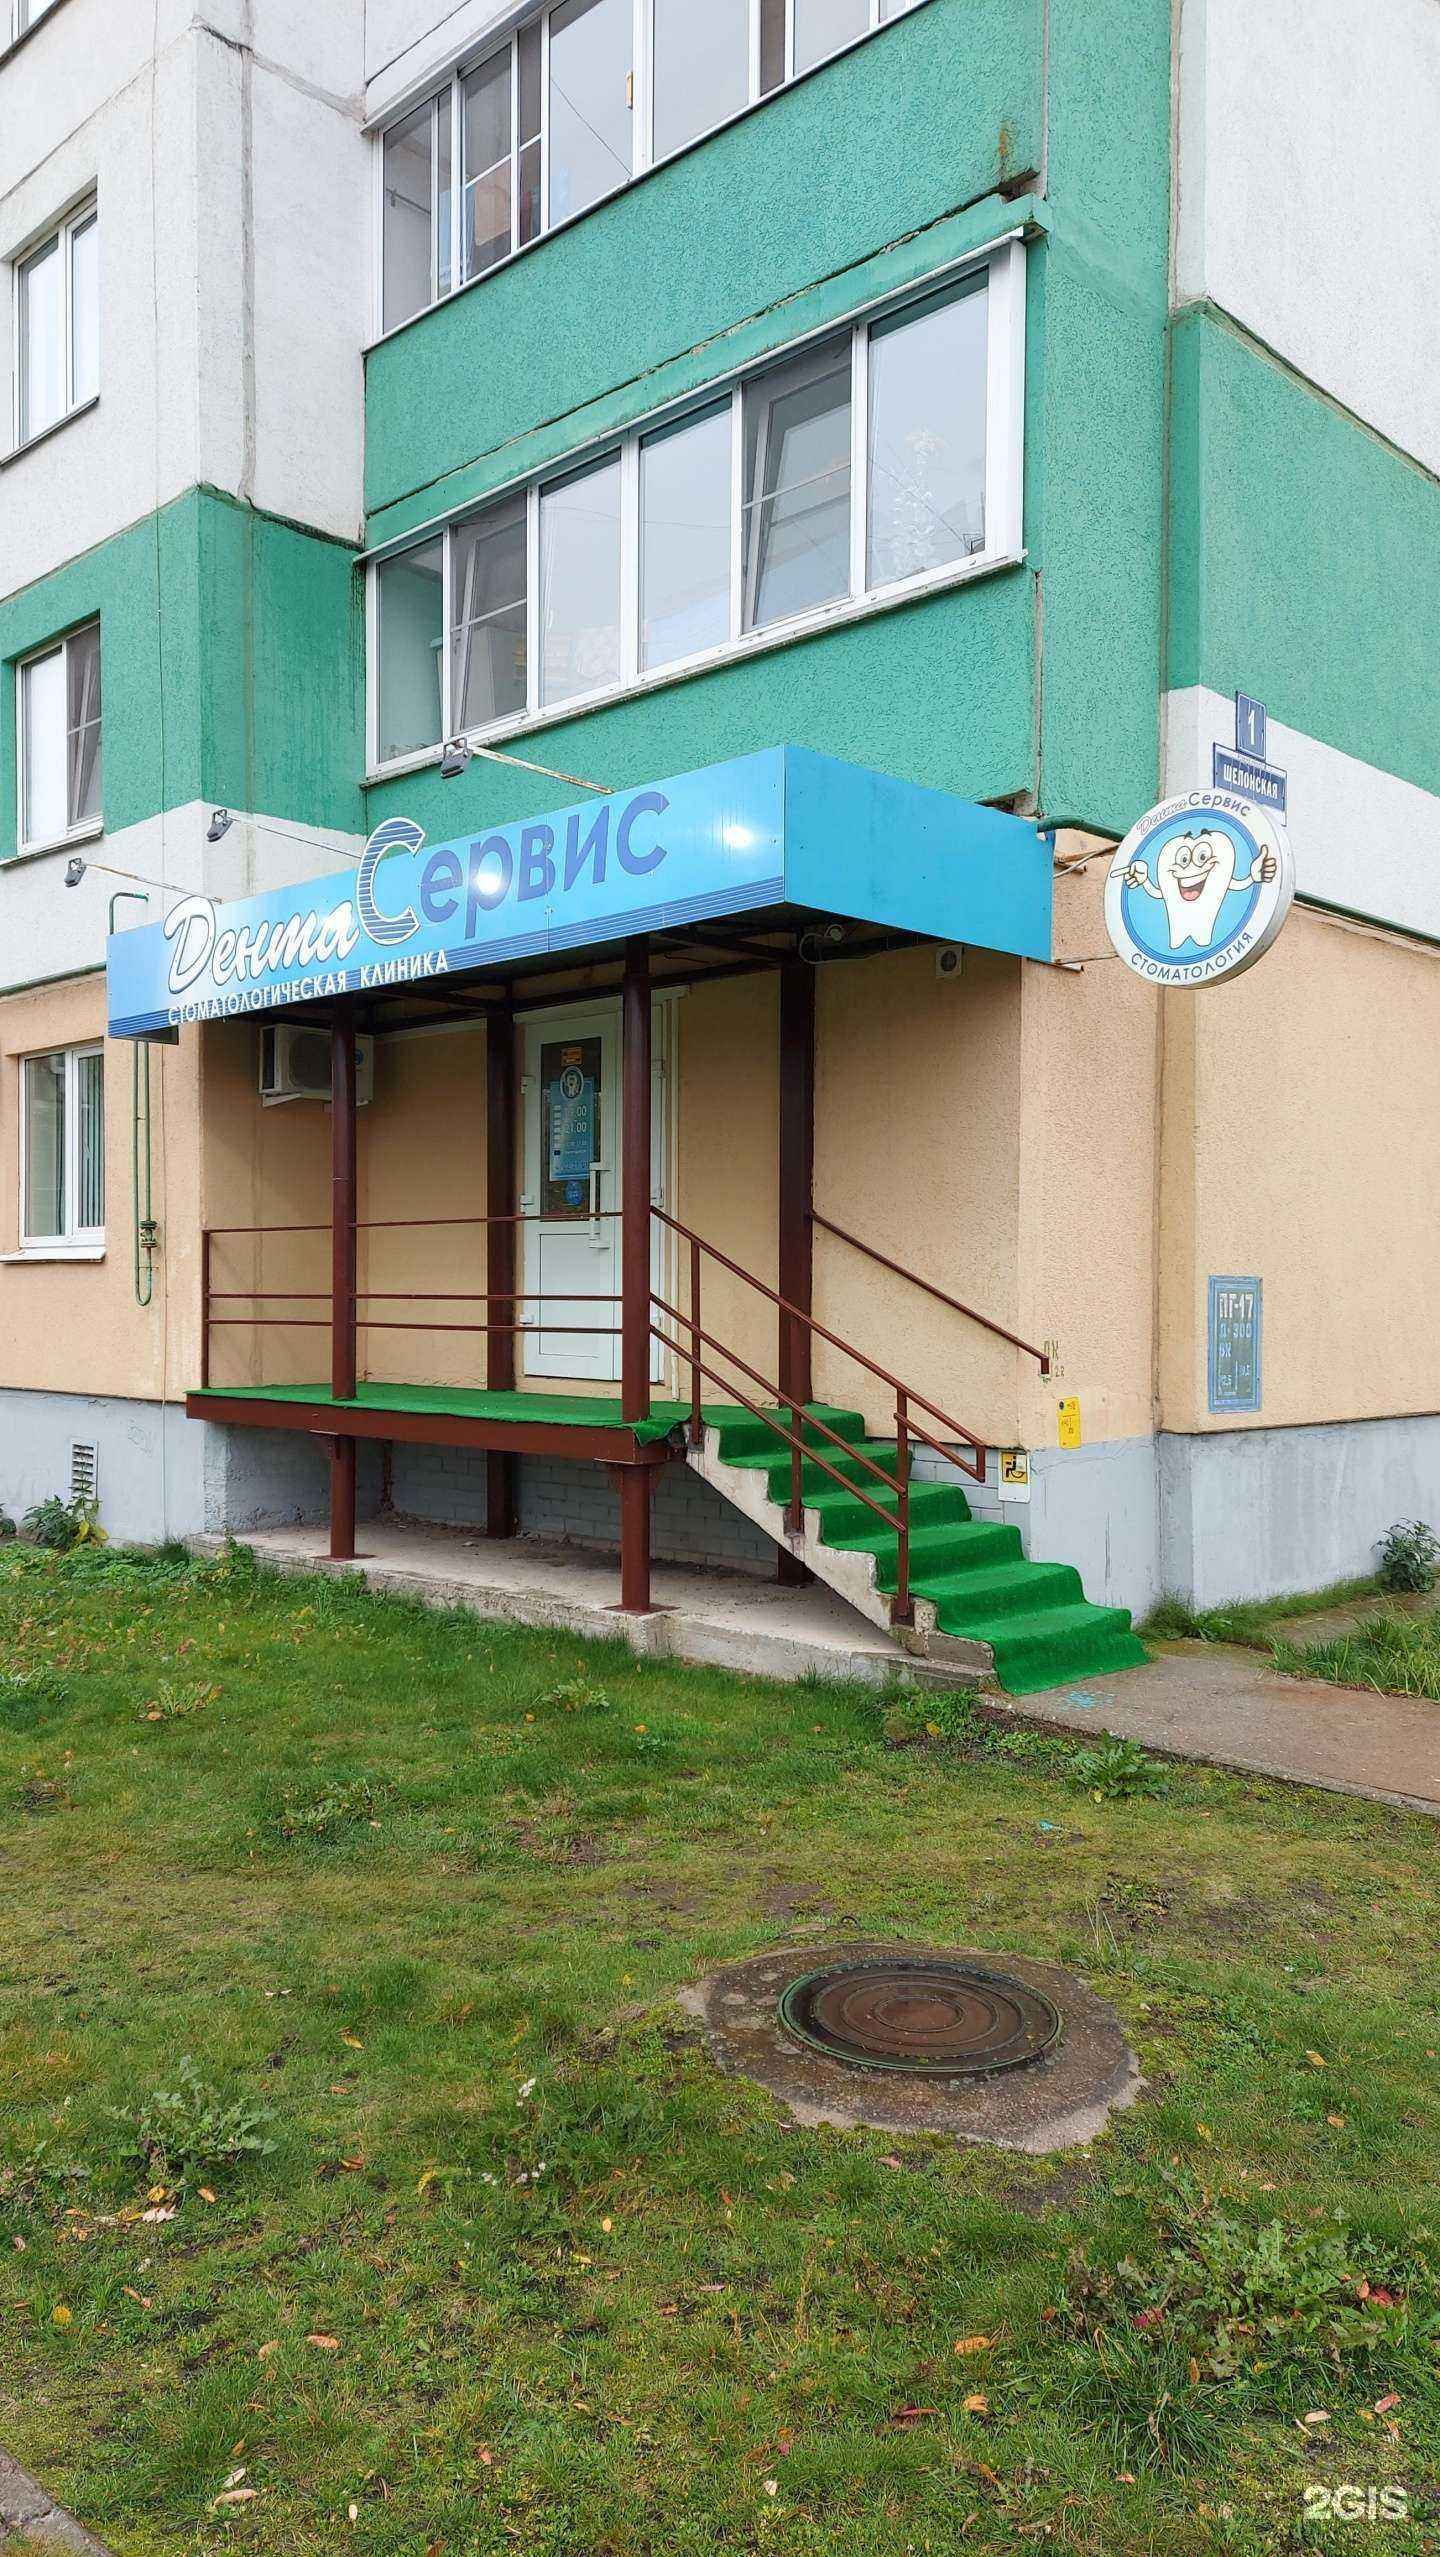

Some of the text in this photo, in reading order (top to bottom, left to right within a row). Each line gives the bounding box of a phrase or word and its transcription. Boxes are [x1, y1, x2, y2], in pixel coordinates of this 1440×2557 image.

[1247, 709, 1256, 746] 1
[1223, 763, 1278, 800] ШЕЛОНСКАЯ
[1131, 931, 1254, 982] СТОМАТОЛОГИЯ
[168, 948, 448, 1026] СТОМАТОЛОГИЧЕСКАЯ КЛИНИКА
